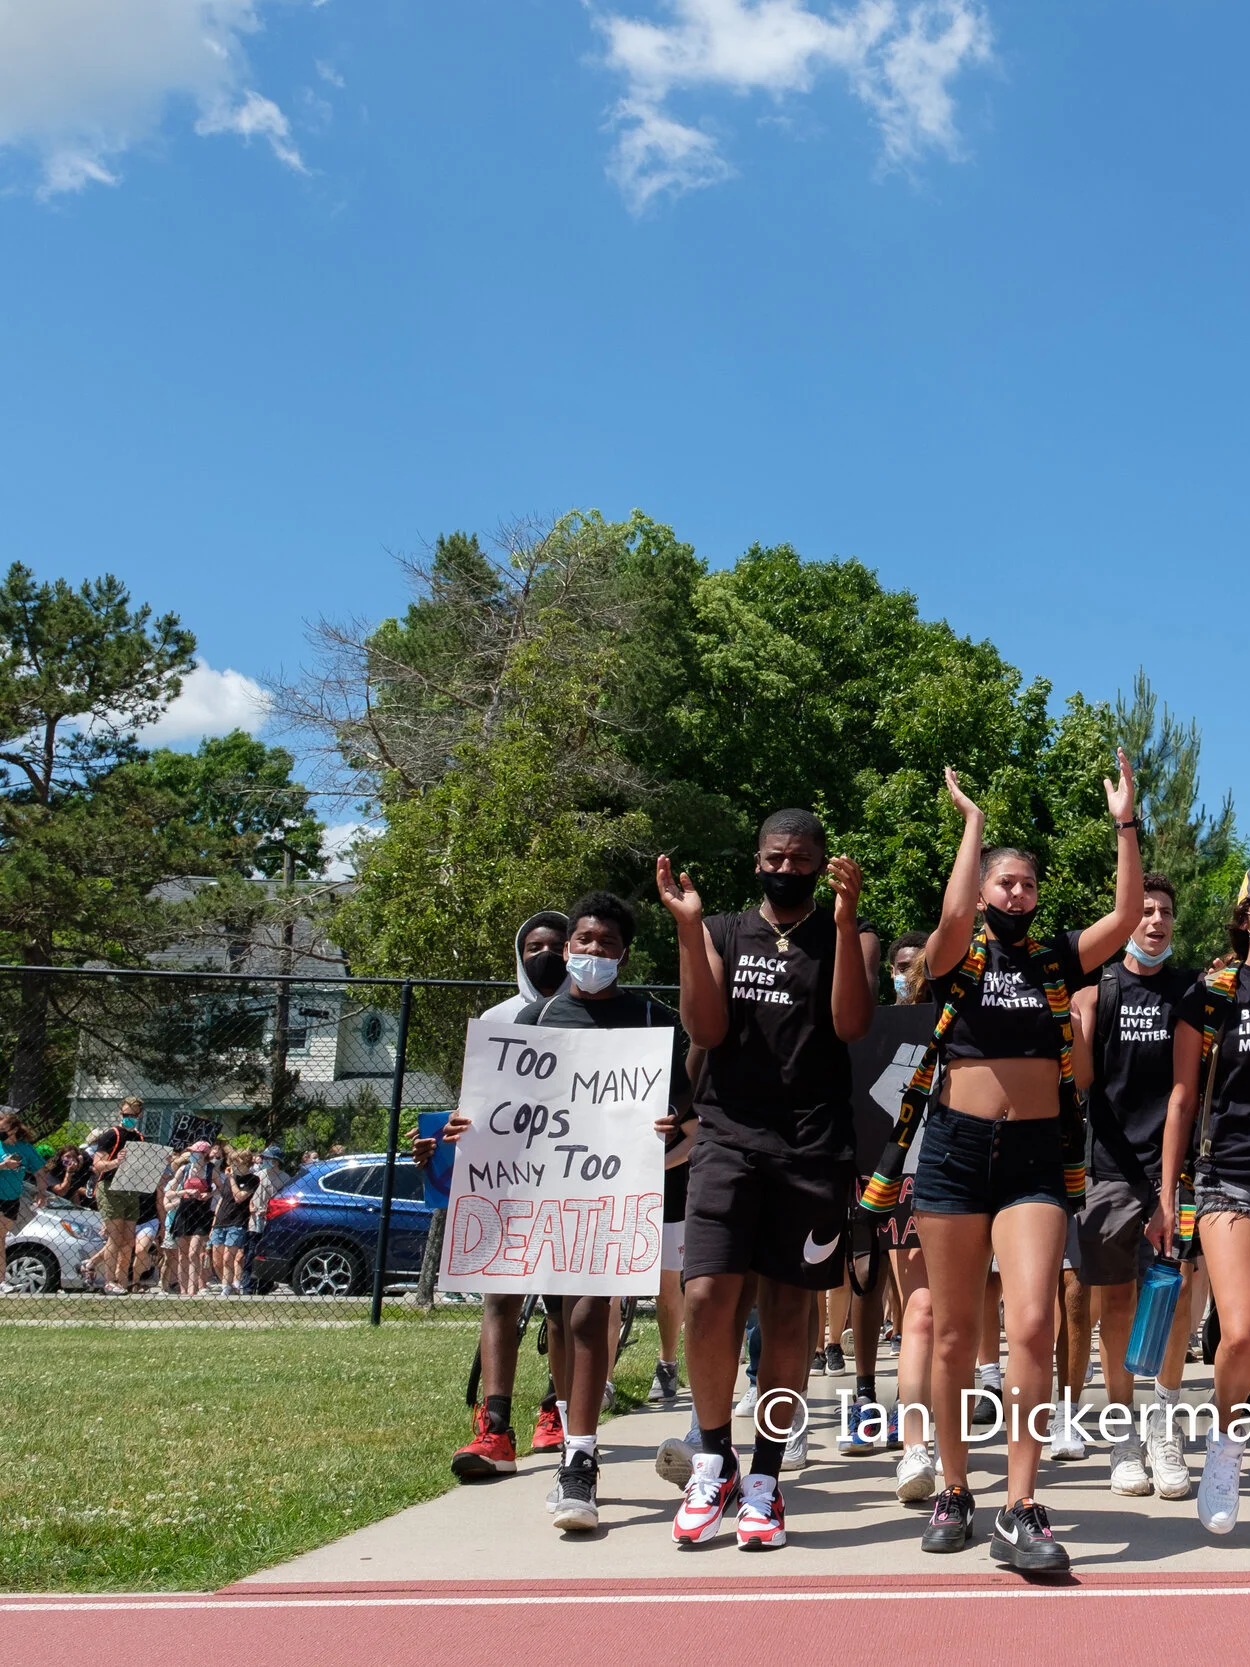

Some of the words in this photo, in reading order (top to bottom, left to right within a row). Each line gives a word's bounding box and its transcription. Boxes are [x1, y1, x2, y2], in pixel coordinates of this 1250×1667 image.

[738, 954, 788, 973] BLACK
[733, 970, 776, 986] LIVES
[983, 970, 1024, 985] BLACK
[732, 986, 794, 1005] MATTER.
[983, 980, 1018, 998] LIVES
[981, 994, 1044, 1009] MATTER.
[1120, 1005, 1161, 1017] BLACK
[1120, 1017, 1153, 1029] LIVES
[1120, 1029, 1171, 1042] MATTER.
[571, 1067, 663, 1104] MANY
[468, 1160, 545, 1192] MANY
[447, 1192, 663, 1277] DEATHS
